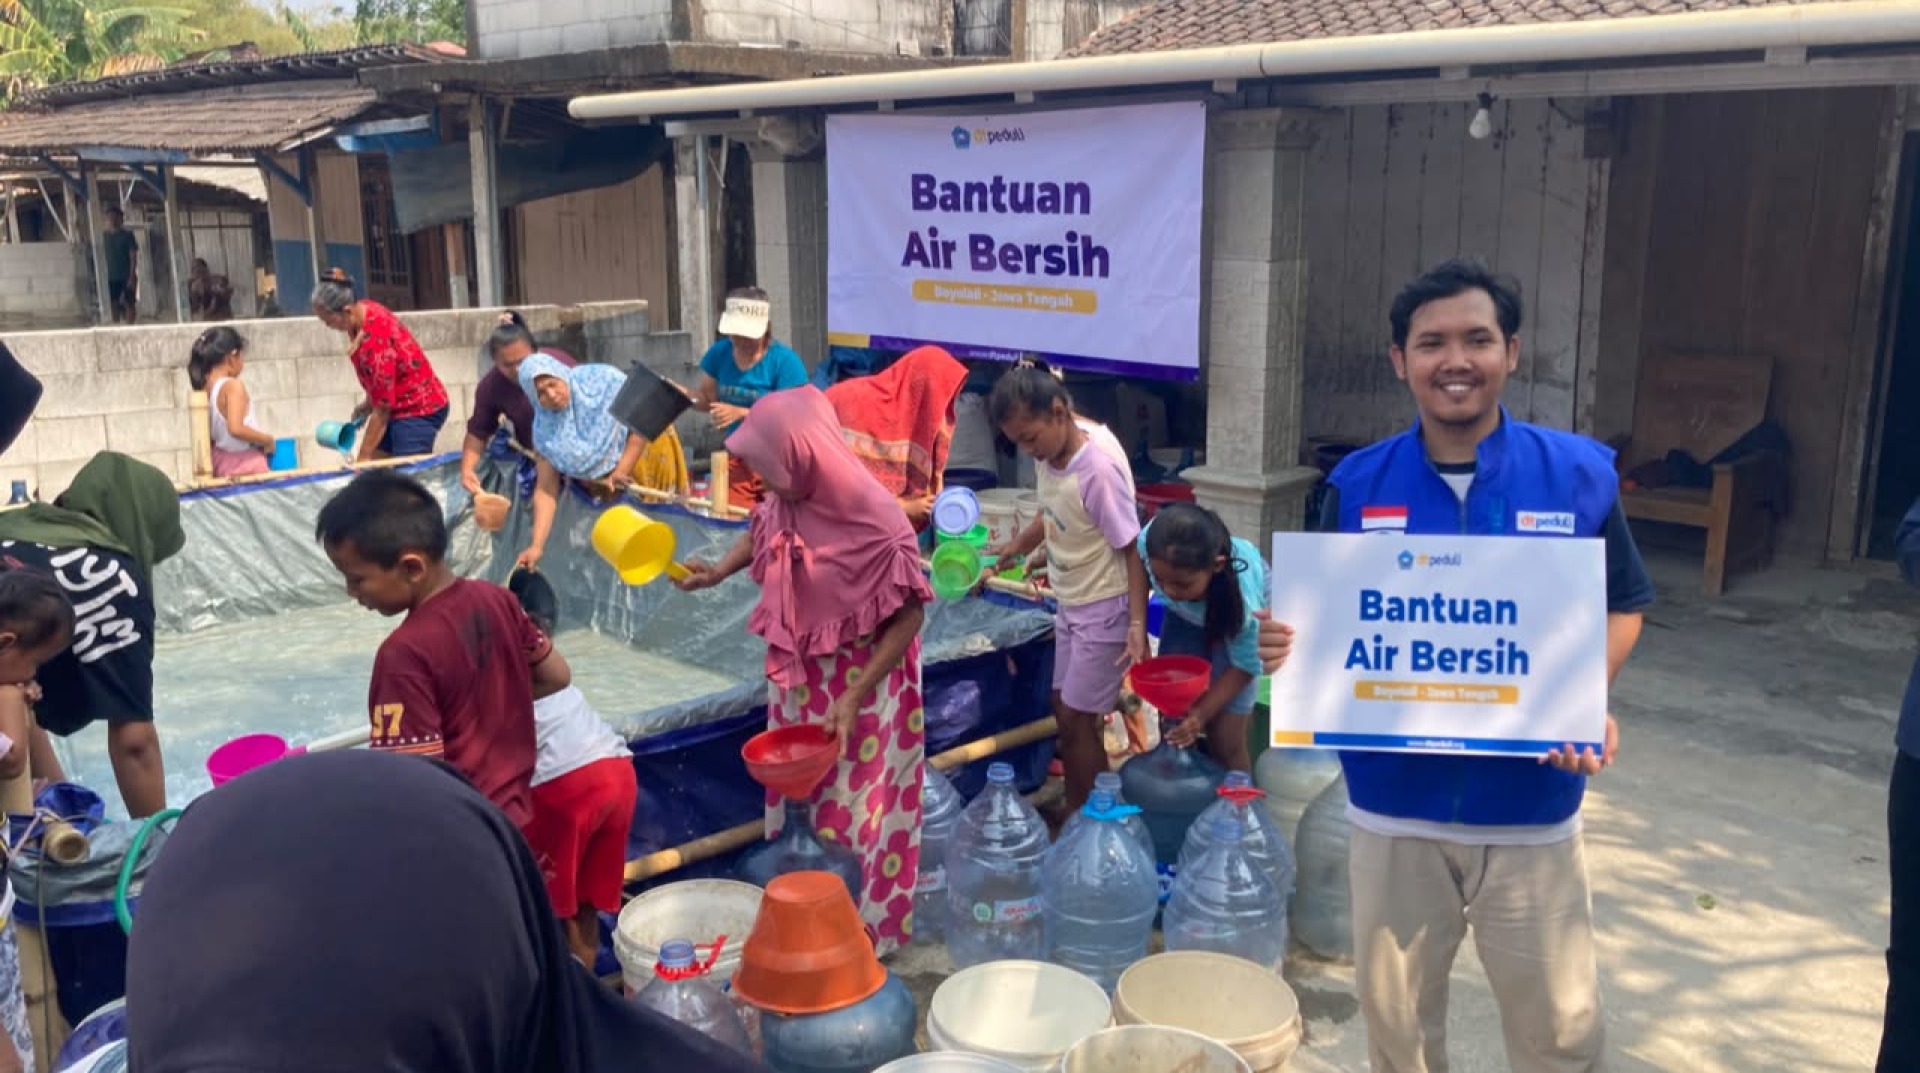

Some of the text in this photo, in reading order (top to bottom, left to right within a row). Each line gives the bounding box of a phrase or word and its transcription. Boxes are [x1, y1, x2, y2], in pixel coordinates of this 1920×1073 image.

[911, 173, 1091, 215] Bantuan
[902, 226, 1110, 278] Air Bersih
[1359, 589, 1518, 625] Bantuan
[1345, 634, 1529, 675] Air Bersih
